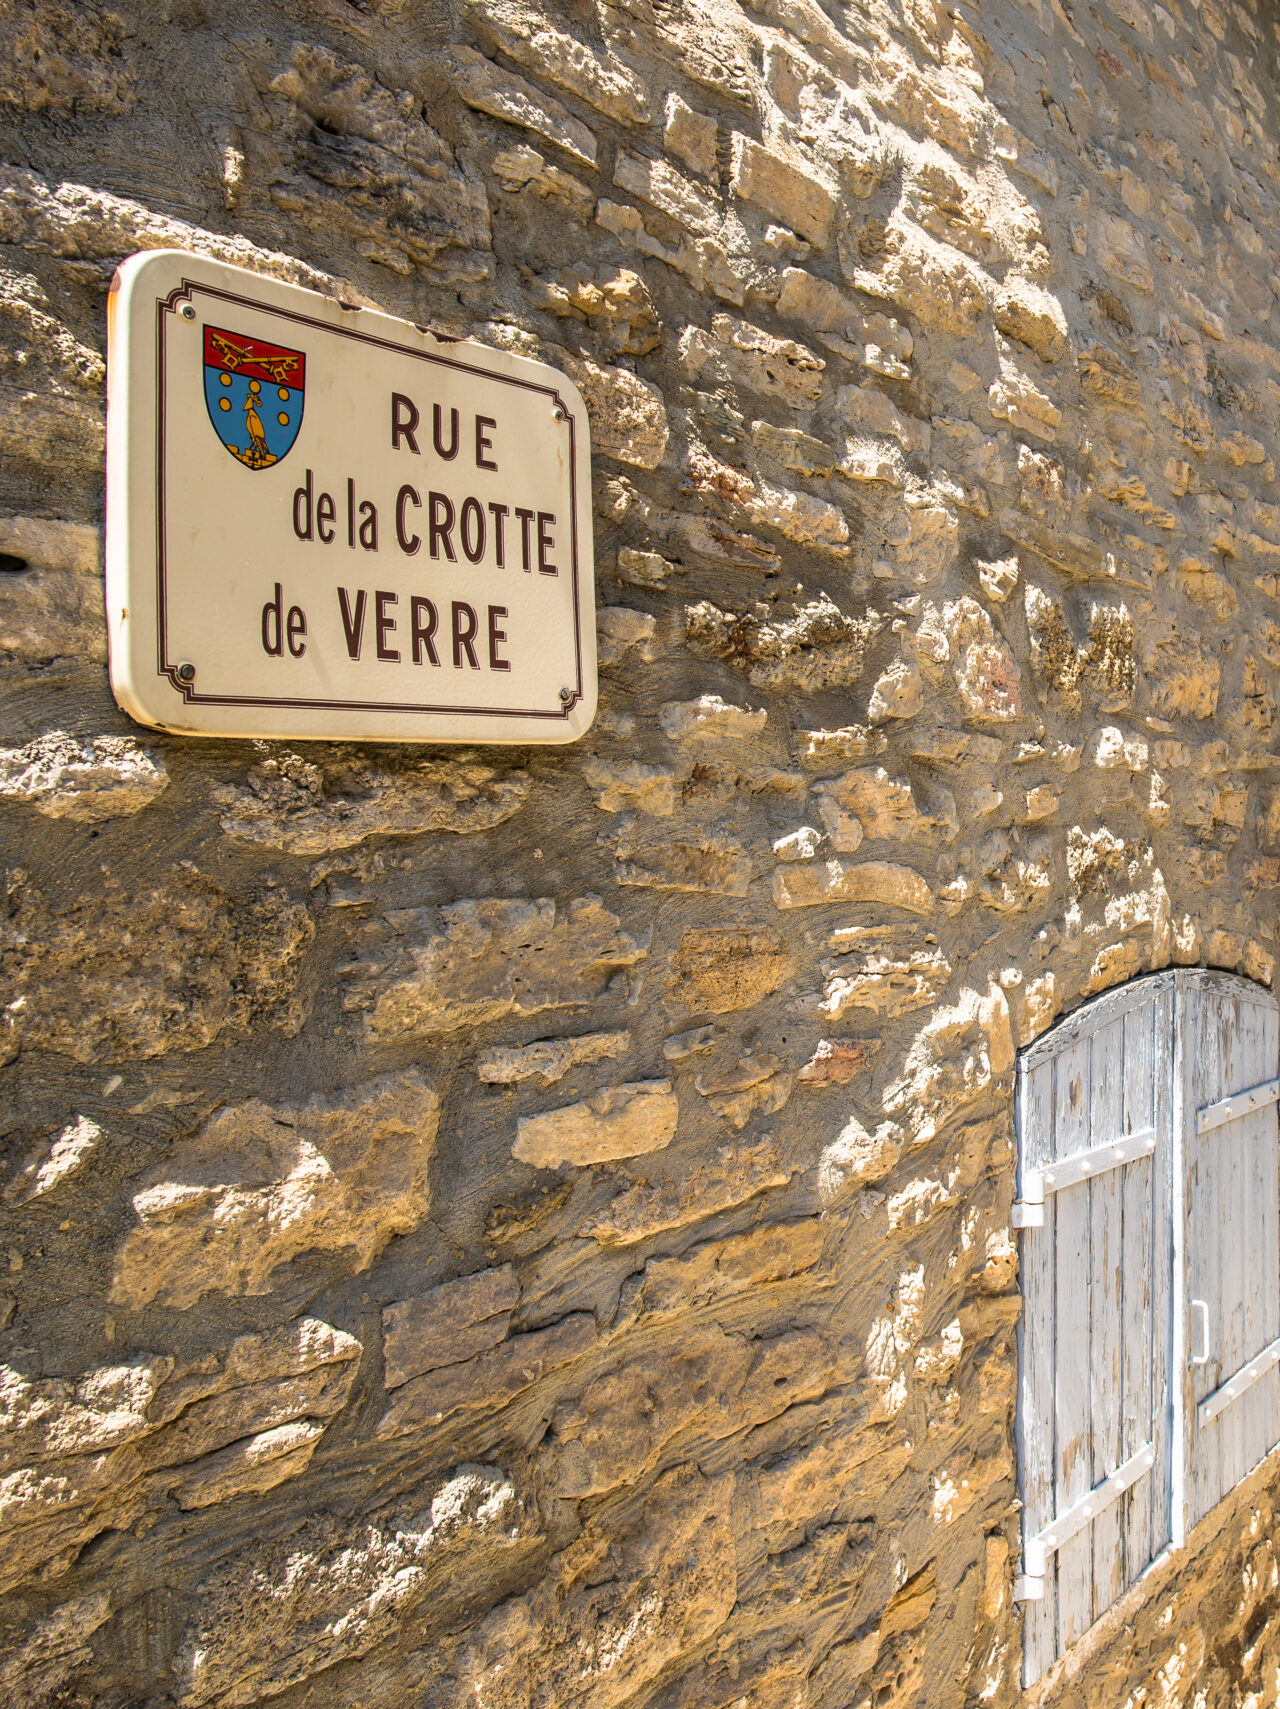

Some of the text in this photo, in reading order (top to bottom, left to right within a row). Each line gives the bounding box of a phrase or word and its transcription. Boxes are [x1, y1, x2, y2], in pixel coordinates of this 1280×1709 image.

[391, 392, 498, 471] RUE
[292, 469, 558, 577] de la CROTTE
[261, 582, 512, 672] de VERRE
